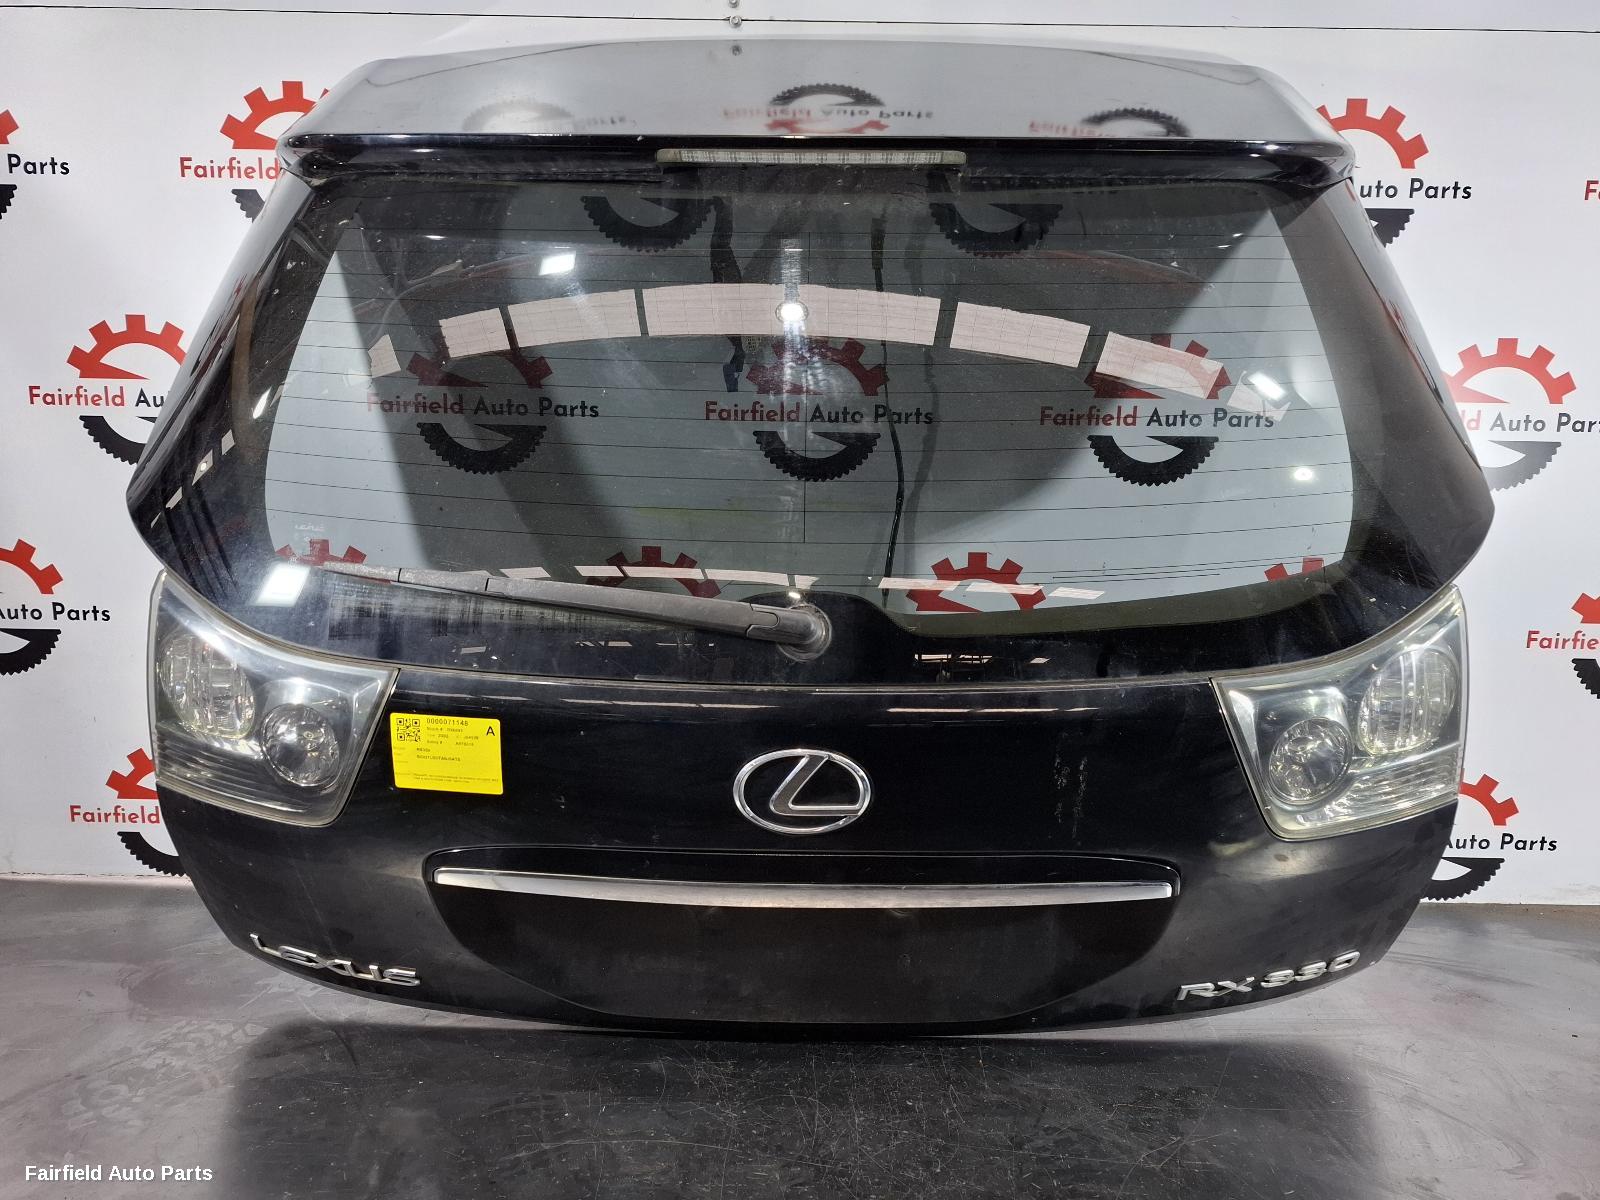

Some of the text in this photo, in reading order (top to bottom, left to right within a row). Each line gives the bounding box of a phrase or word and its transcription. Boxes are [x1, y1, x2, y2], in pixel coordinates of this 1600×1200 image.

[7, 153, 70, 175] Parts
[179, 157, 280, 180] Fairfield
[1360, 178, 1472, 199] uto Parts
[28, 385, 165, 408] Fairfield Au
[367, 393, 599, 418] Fairfield Auto Parts
[704, 400, 934, 425] Fairfield Auto Parts
[1039, 406, 1275, 429] Fairfield Auto Parts
[1489, 411, 1546, 432] Auto
[1556, 412, 1600, 433] Par
[52, 601, 111, 622] Parts
[1526, 630, 1600, 650] Fairfie
[486, 725, 496, 737] A
[69, 805, 160, 824] Fairfield
[1500, 832, 1558, 852] Parts
[249, 933, 421, 987] LEXUS
[1177, 976, 1255, 1001] RX
